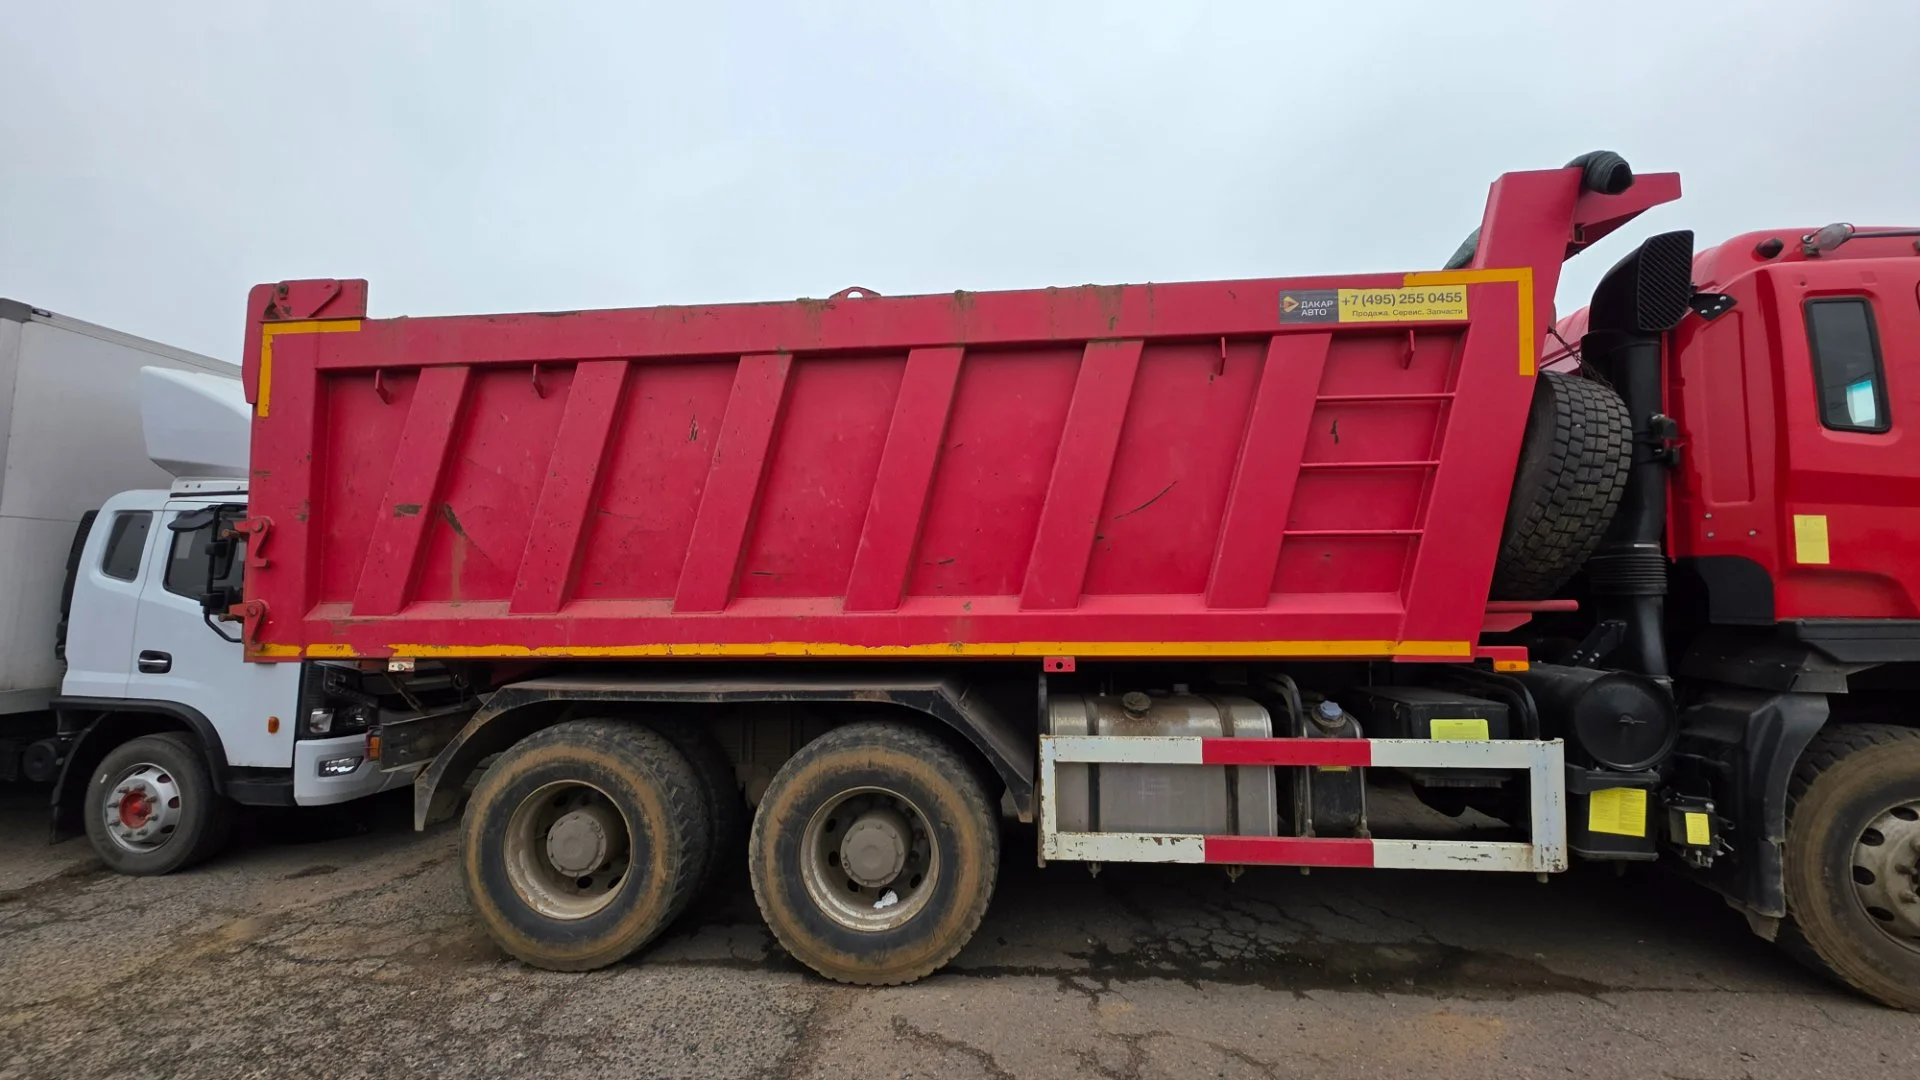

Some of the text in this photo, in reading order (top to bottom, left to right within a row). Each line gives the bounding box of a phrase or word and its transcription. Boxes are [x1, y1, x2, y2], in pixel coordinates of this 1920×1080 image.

[1342, 292, 1462, 307] +7 (495) 255 0455
[1301, 300, 1333, 309] ДАКАР
[1301, 308, 1327, 316] АВТО
